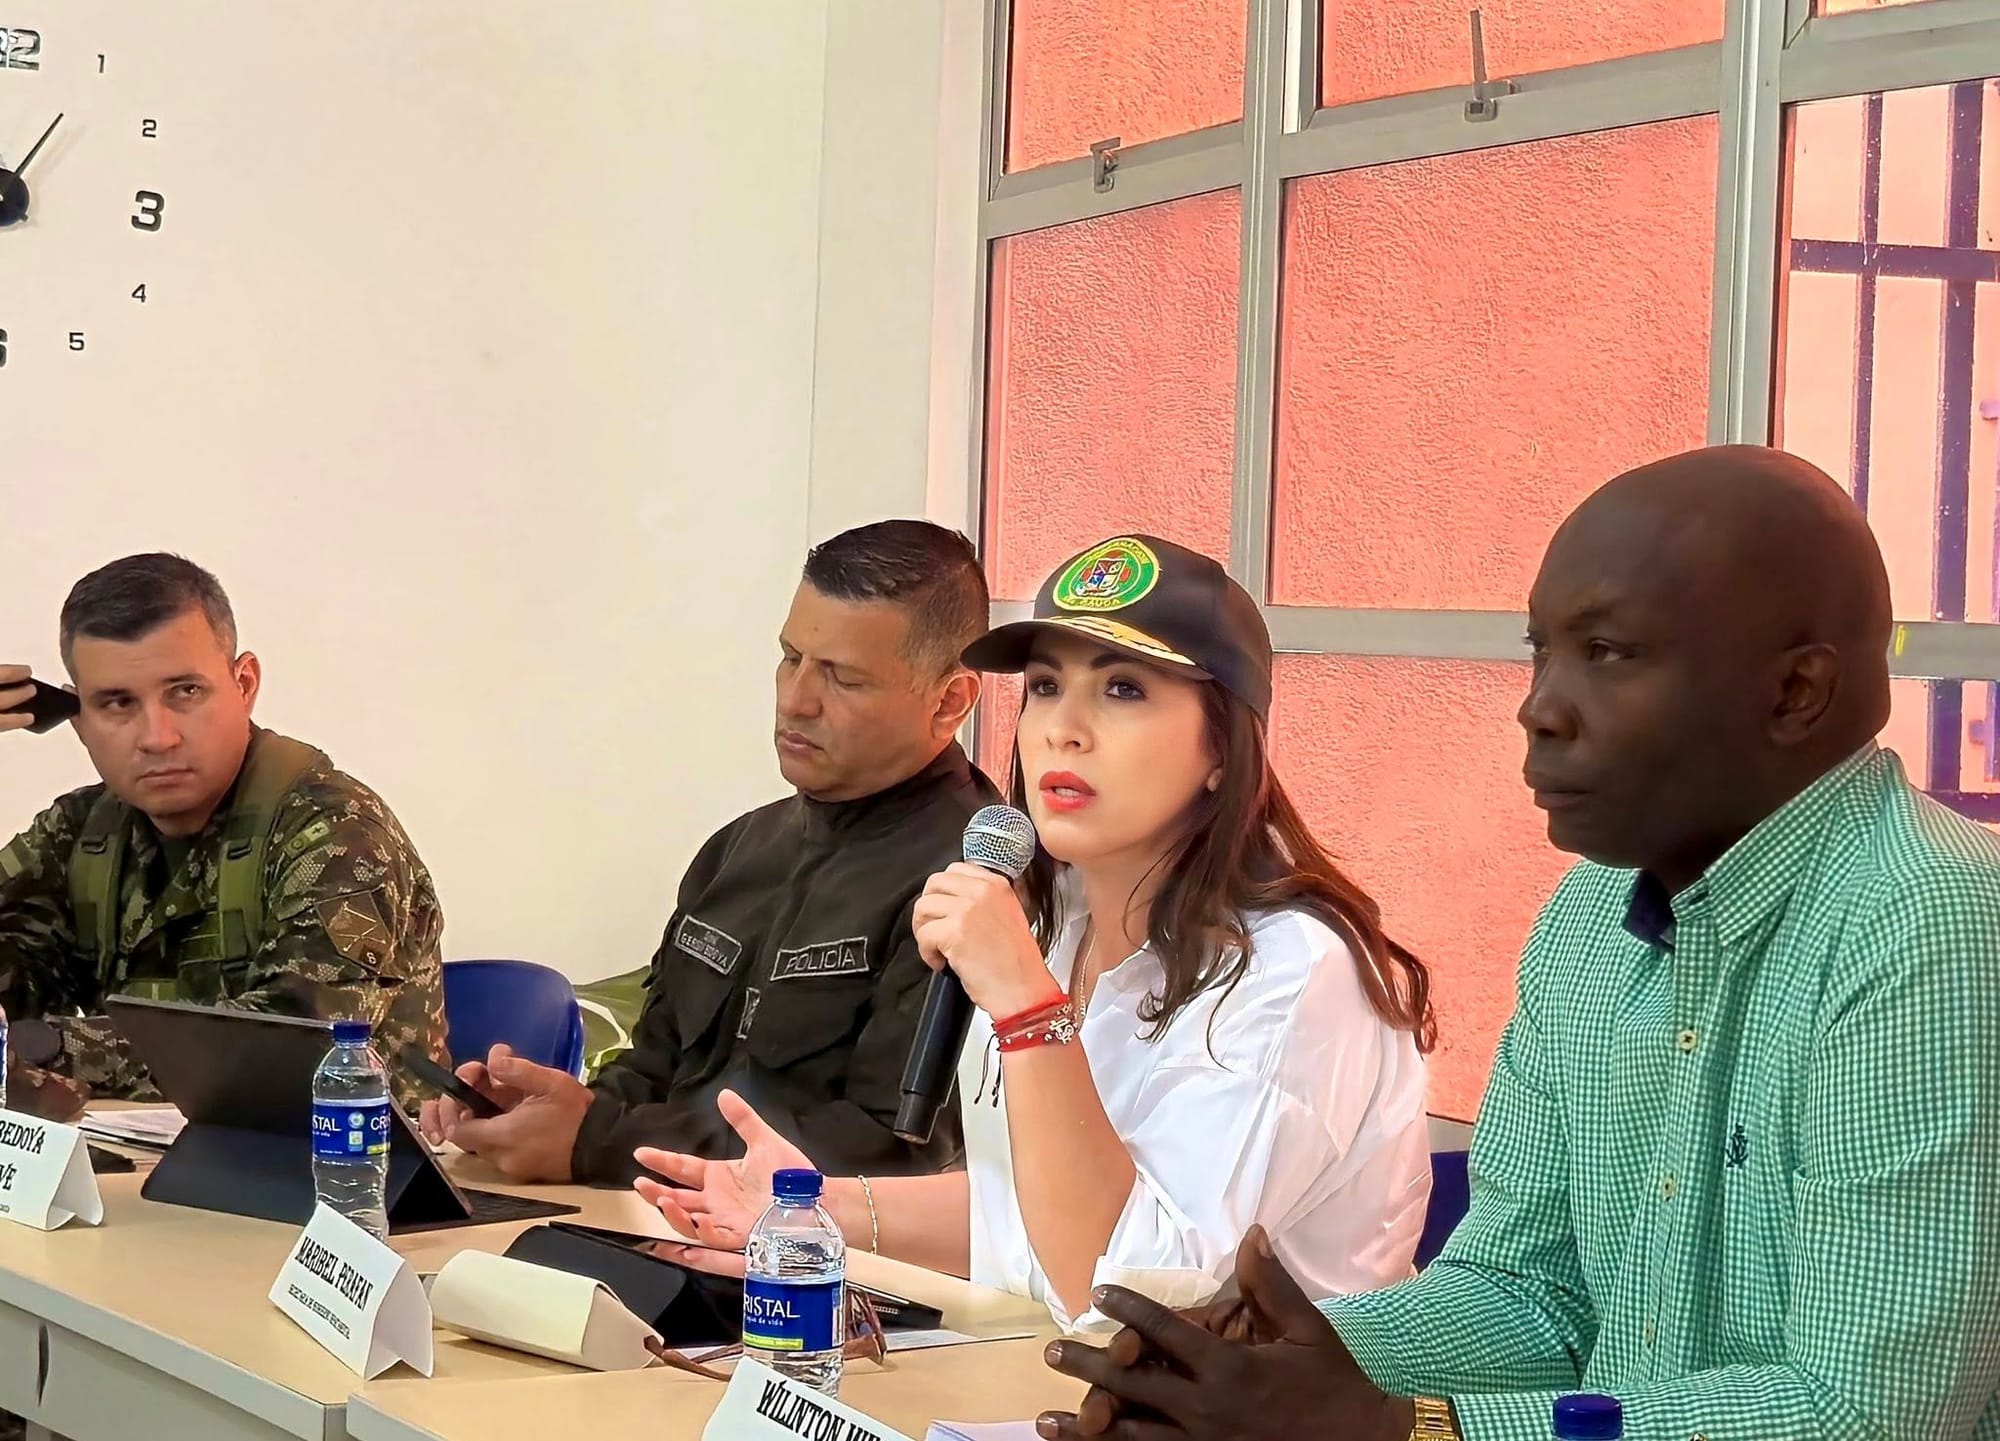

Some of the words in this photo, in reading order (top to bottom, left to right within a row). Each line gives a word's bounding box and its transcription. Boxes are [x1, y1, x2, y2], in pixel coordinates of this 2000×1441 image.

[97, 54, 105, 74] 1
[142, 119, 157, 138] 2
[131, 190, 165, 232] 3
[131, 283, 147, 303] 4
[69, 332, 85, 351] 5
